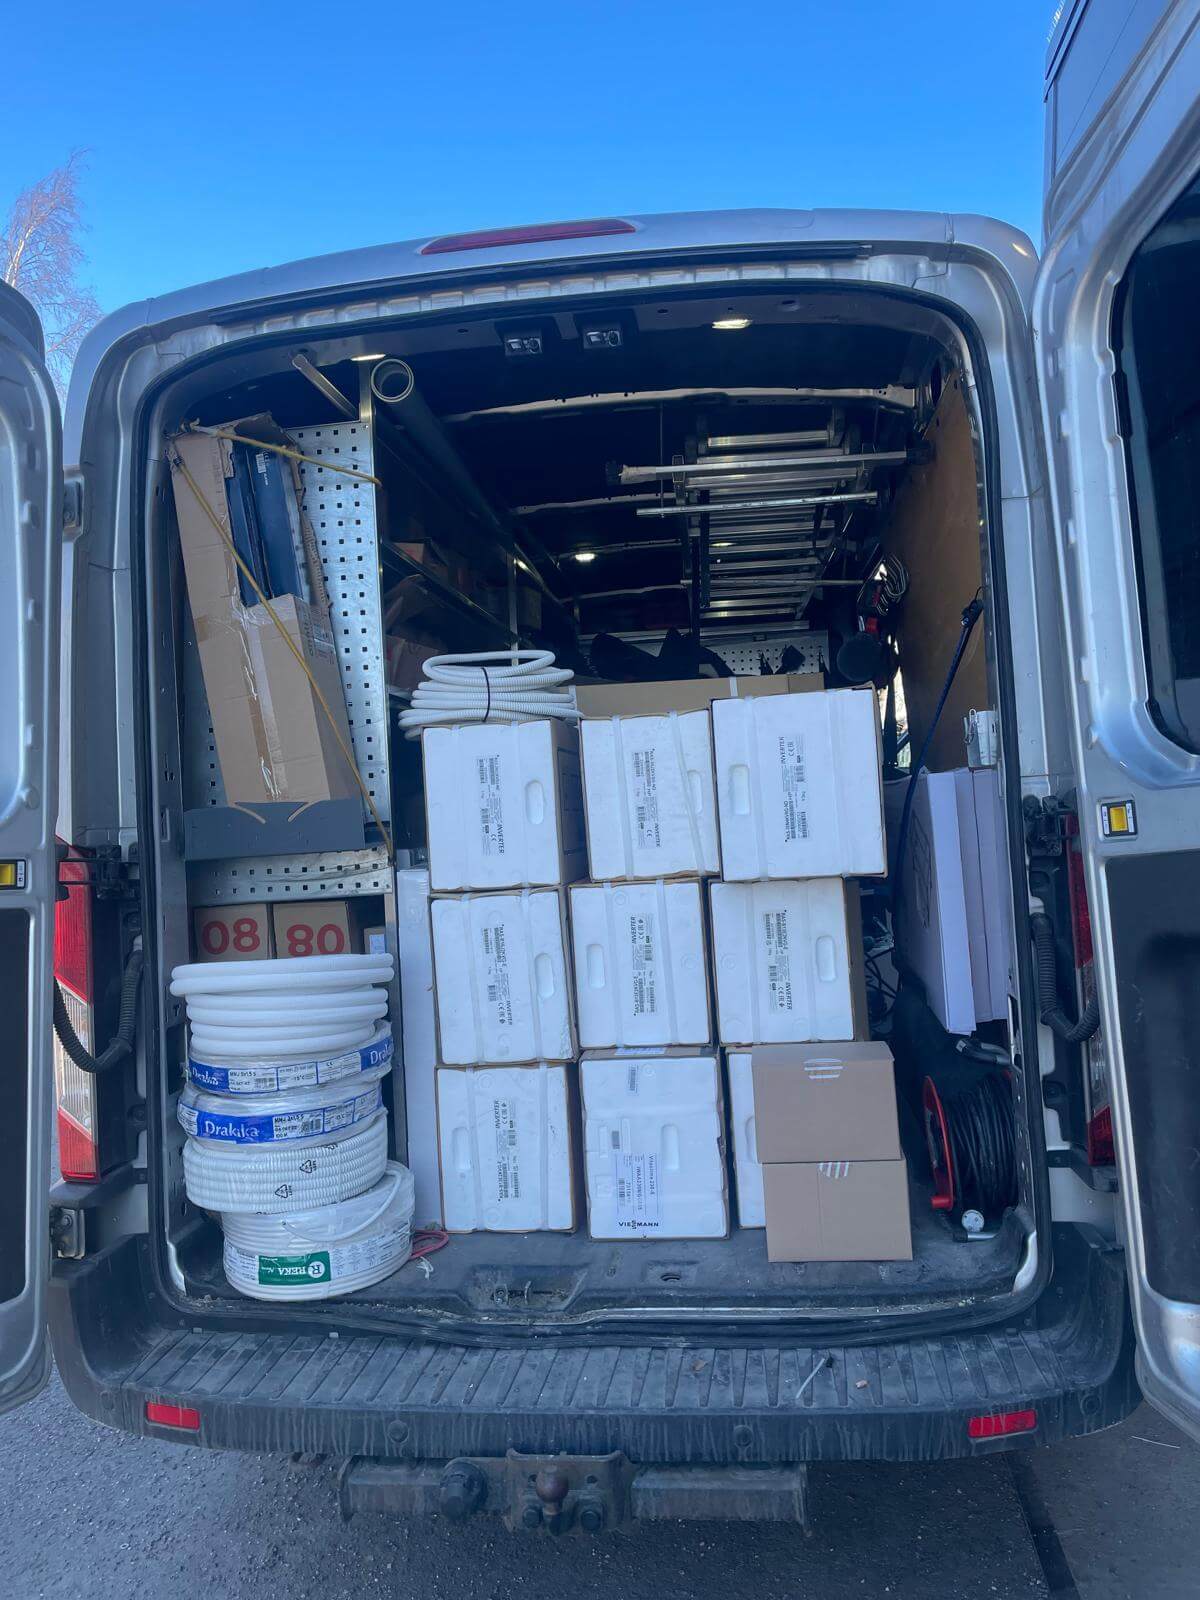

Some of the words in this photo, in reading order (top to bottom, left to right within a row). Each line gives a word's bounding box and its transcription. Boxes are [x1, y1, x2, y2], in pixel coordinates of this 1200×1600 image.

[778, 736, 786, 764] INVERTER
[202, 917, 260, 955] 08
[785, 982, 793, 1010] INVERTER
[278, 1266, 306, 1275] REKA
